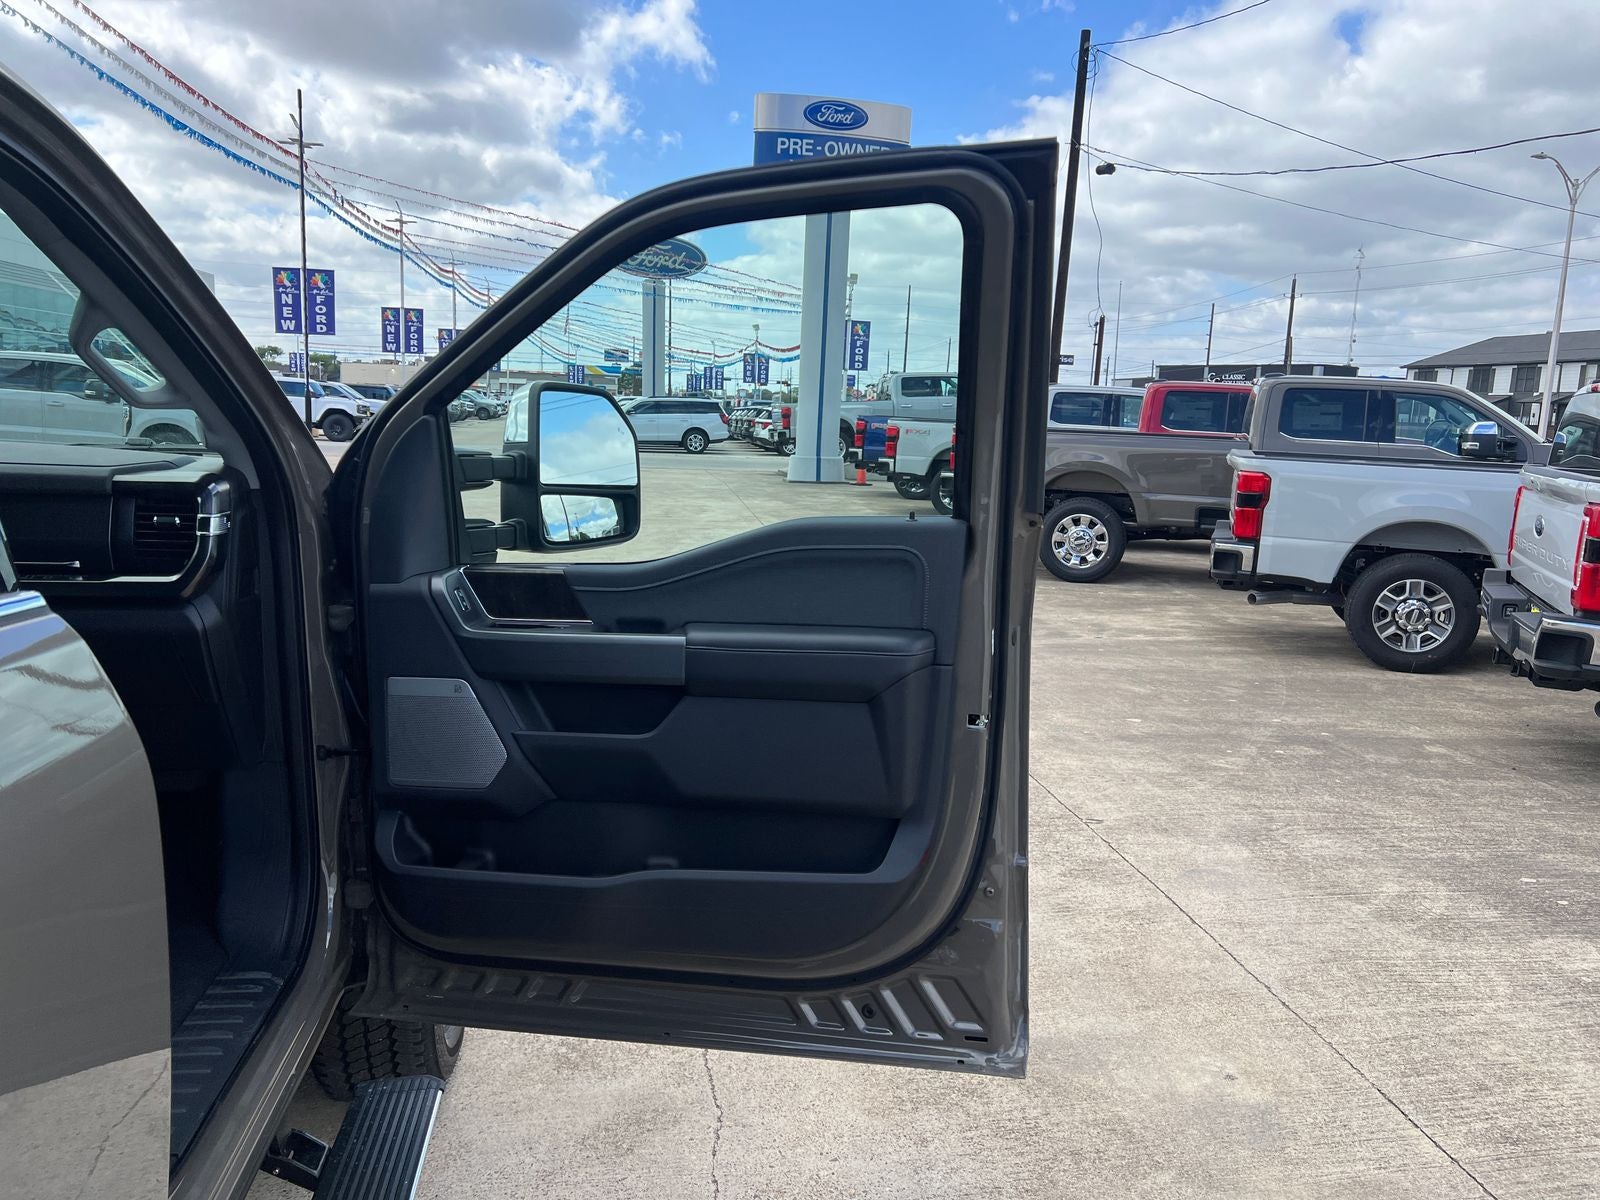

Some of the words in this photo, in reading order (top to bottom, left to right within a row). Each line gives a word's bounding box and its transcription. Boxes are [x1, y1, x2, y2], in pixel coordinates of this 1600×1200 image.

[817, 104, 853, 125] Ford
[627, 243, 687, 269] Ford
[281, 293, 296, 331] NEW
[315, 295, 327, 333] FORD
[386, 325, 396, 351] NEW
[409, 326, 418, 353] FORD
[855, 340, 863, 369] FORD
[1539, 549, 1568, 570] DUTY
